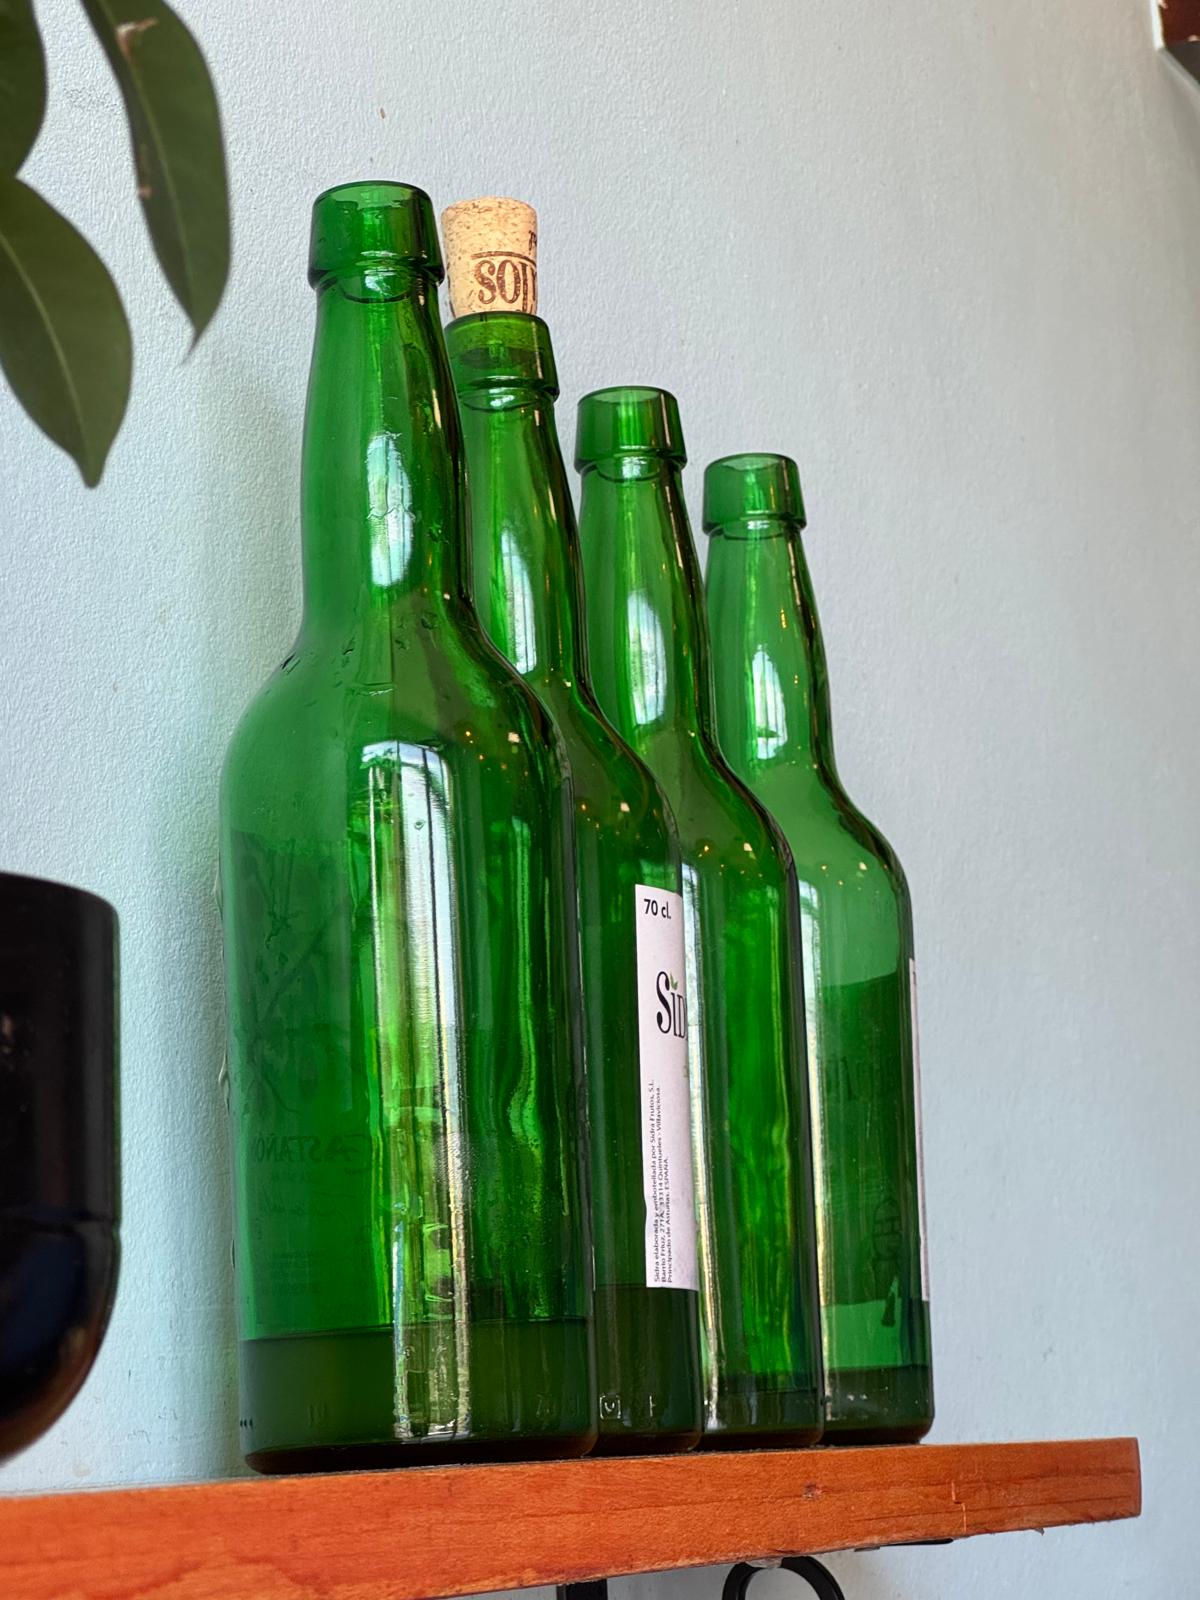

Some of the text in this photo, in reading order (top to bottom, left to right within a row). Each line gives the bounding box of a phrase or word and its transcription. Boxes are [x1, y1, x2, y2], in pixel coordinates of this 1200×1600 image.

[643, 898, 658, 917] 70
[656, 1137, 664, 1181] Quintueles
[650, 1160, 659, 1211] embotellada
[652, 1219, 660, 1260] elaborada
[665, 1238, 673, 1283] Principado
[653, 1261, 661, 1283] Sidra
